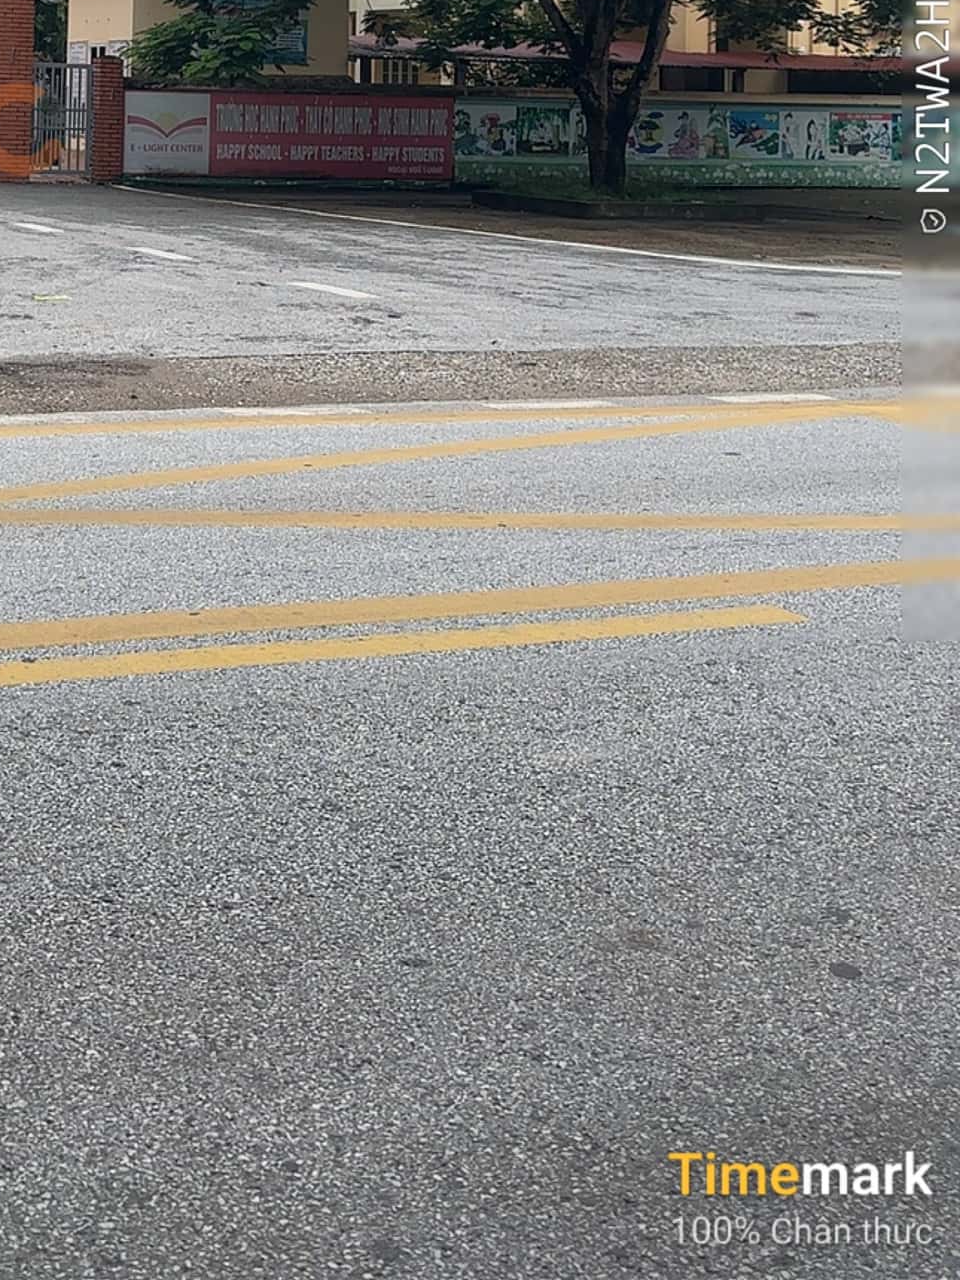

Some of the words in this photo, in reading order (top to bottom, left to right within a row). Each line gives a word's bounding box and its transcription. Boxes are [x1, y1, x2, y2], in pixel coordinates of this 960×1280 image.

[143, 144, 169, 153] LIGHT
[170, 144, 204, 153] CENTER
[216, 143, 246, 160] HAPPY
[247, 143, 282, 161] SCHOOL
[290, 144, 319, 161] HAPPY
[320, 144, 364, 161] TEACHERS
[371, 145, 400, 162] HAPPY
[401, 145, 445, 163] STUDENTS
